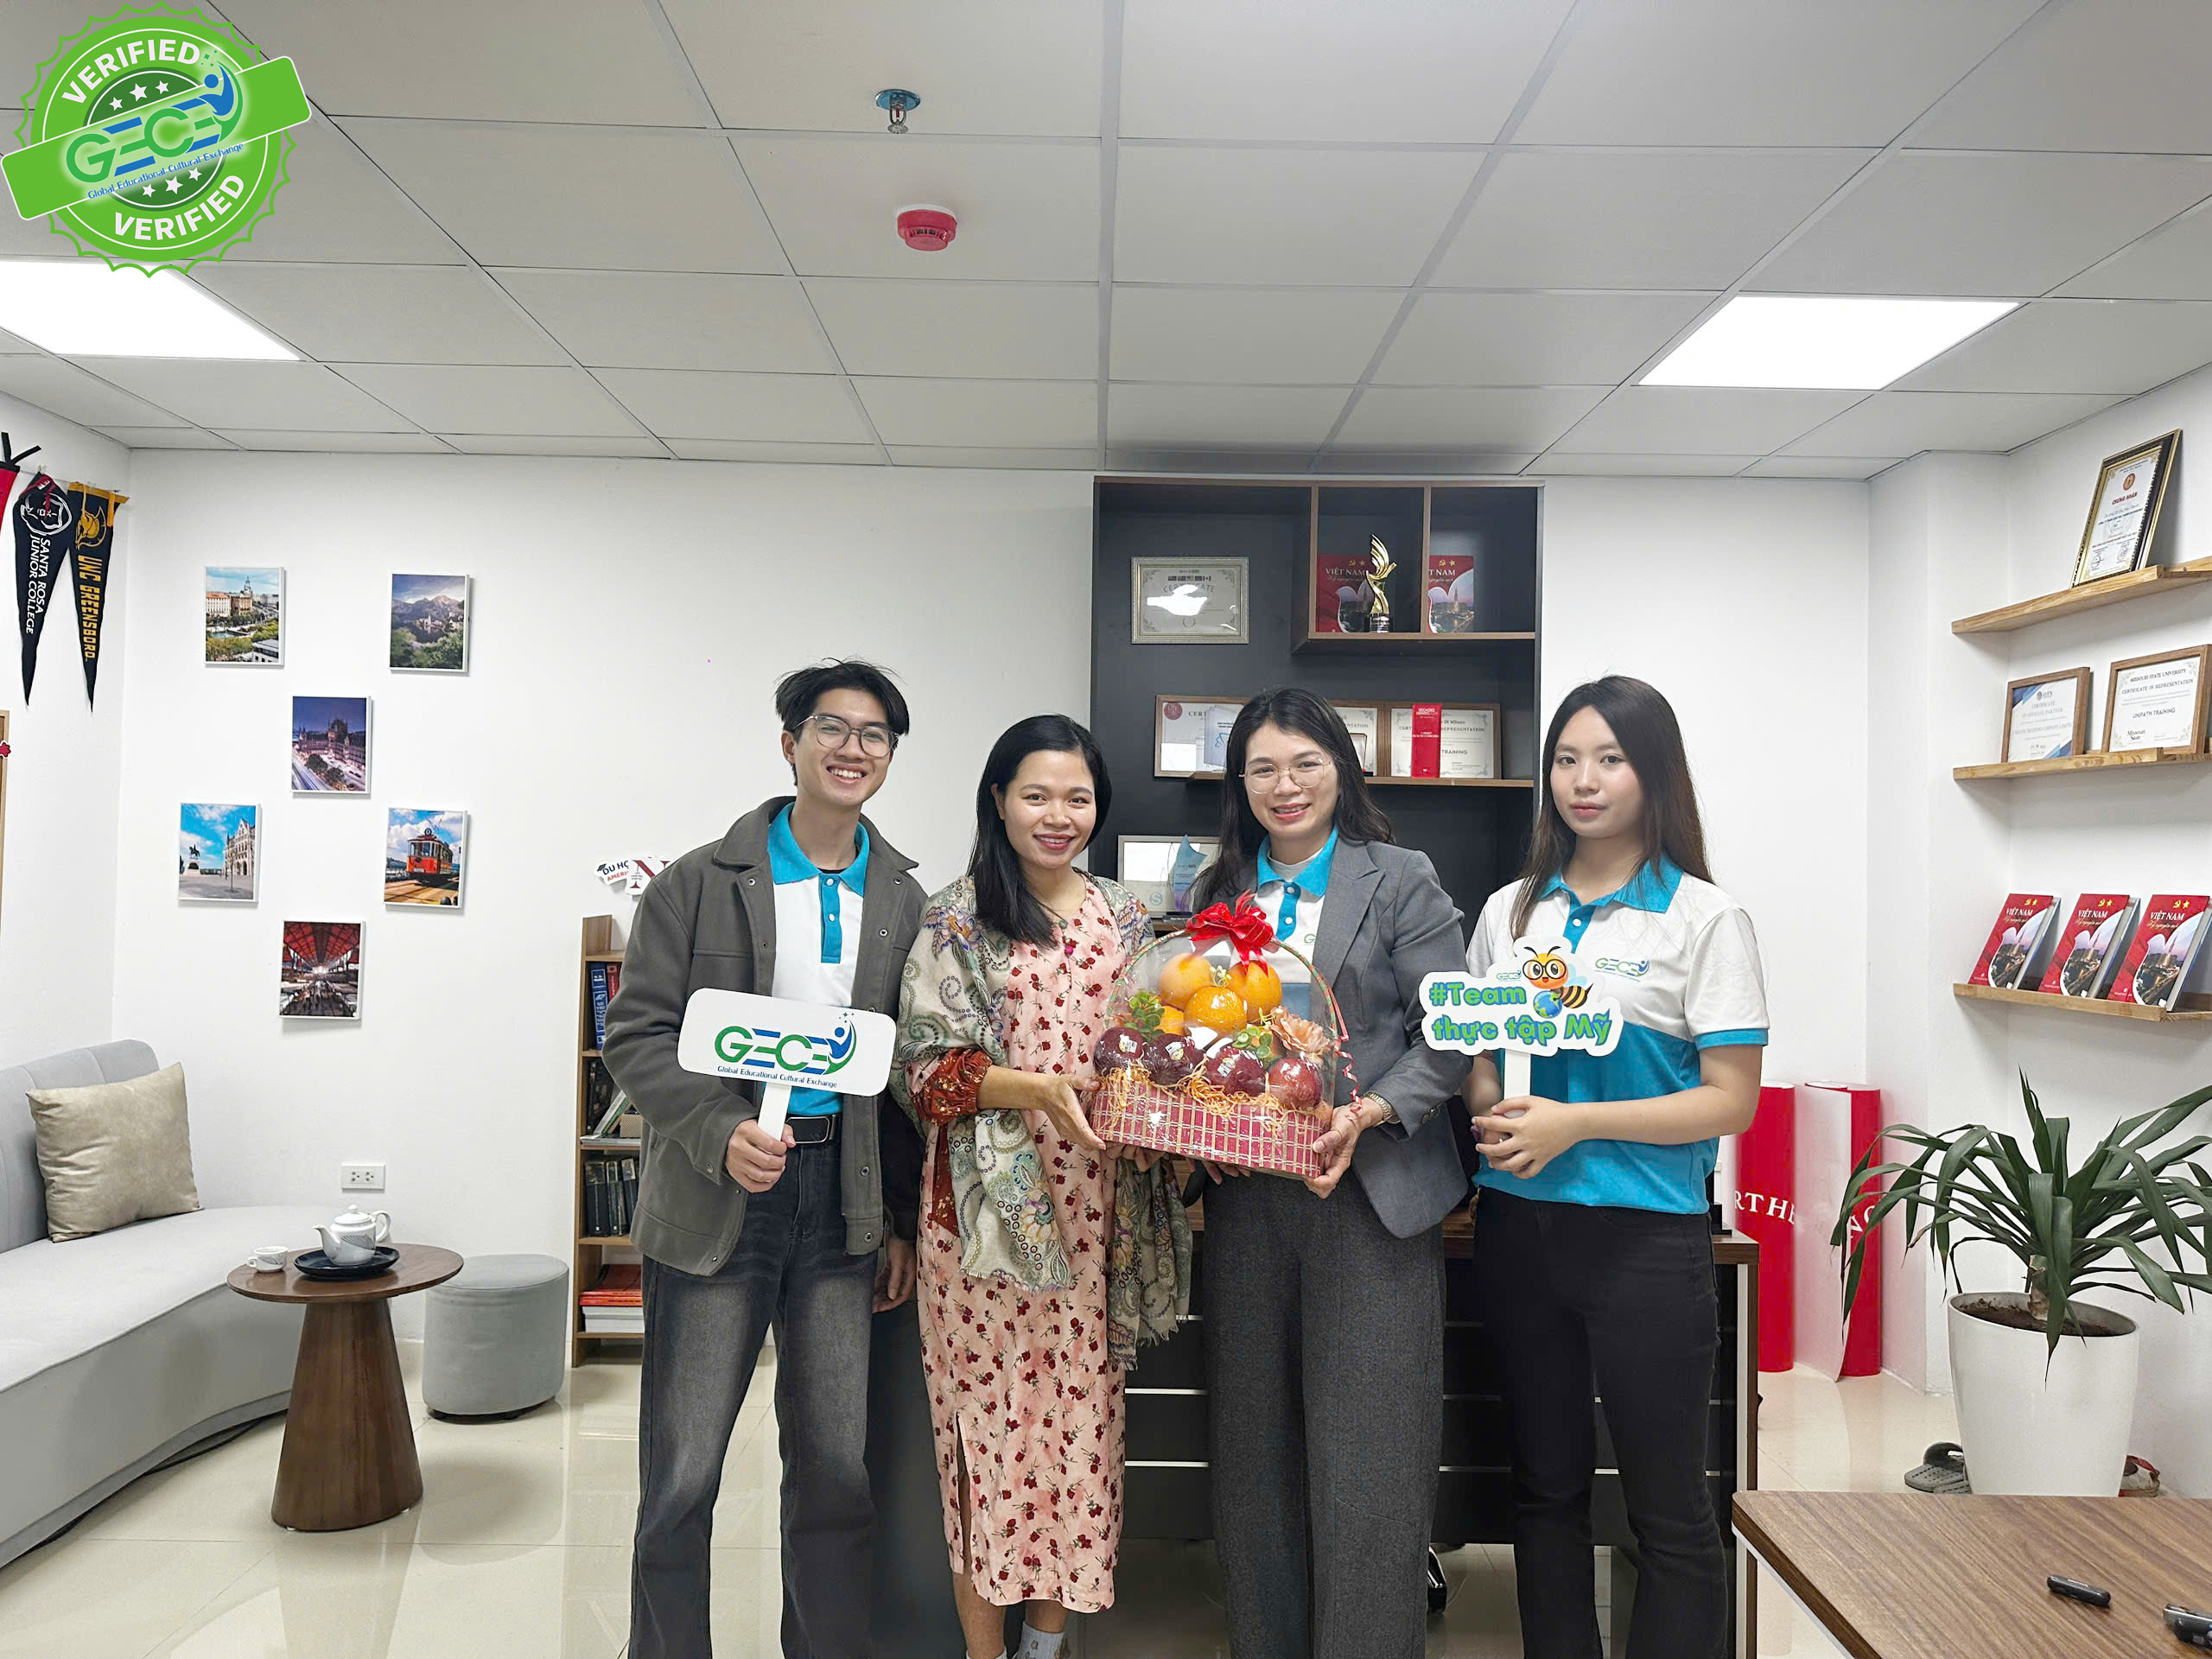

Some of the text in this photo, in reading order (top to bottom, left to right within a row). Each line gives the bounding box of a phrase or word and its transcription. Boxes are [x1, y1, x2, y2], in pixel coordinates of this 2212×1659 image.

[26, 533, 41, 634] JUNIOR COLLEGE
[35, 537, 51, 614] SANTA ROSA
[78, 555, 103, 659] UNC GREENSBORO
[602, 864, 616, 875] DU
[2150, 910, 2185, 921] VIỆT NAM
[1428, 982, 1527, 1006] #Team
[1431, 1007, 1613, 1046] thực tập Mỹ
[717, 1065, 837, 1089] Global Educational Cultural Exchange
